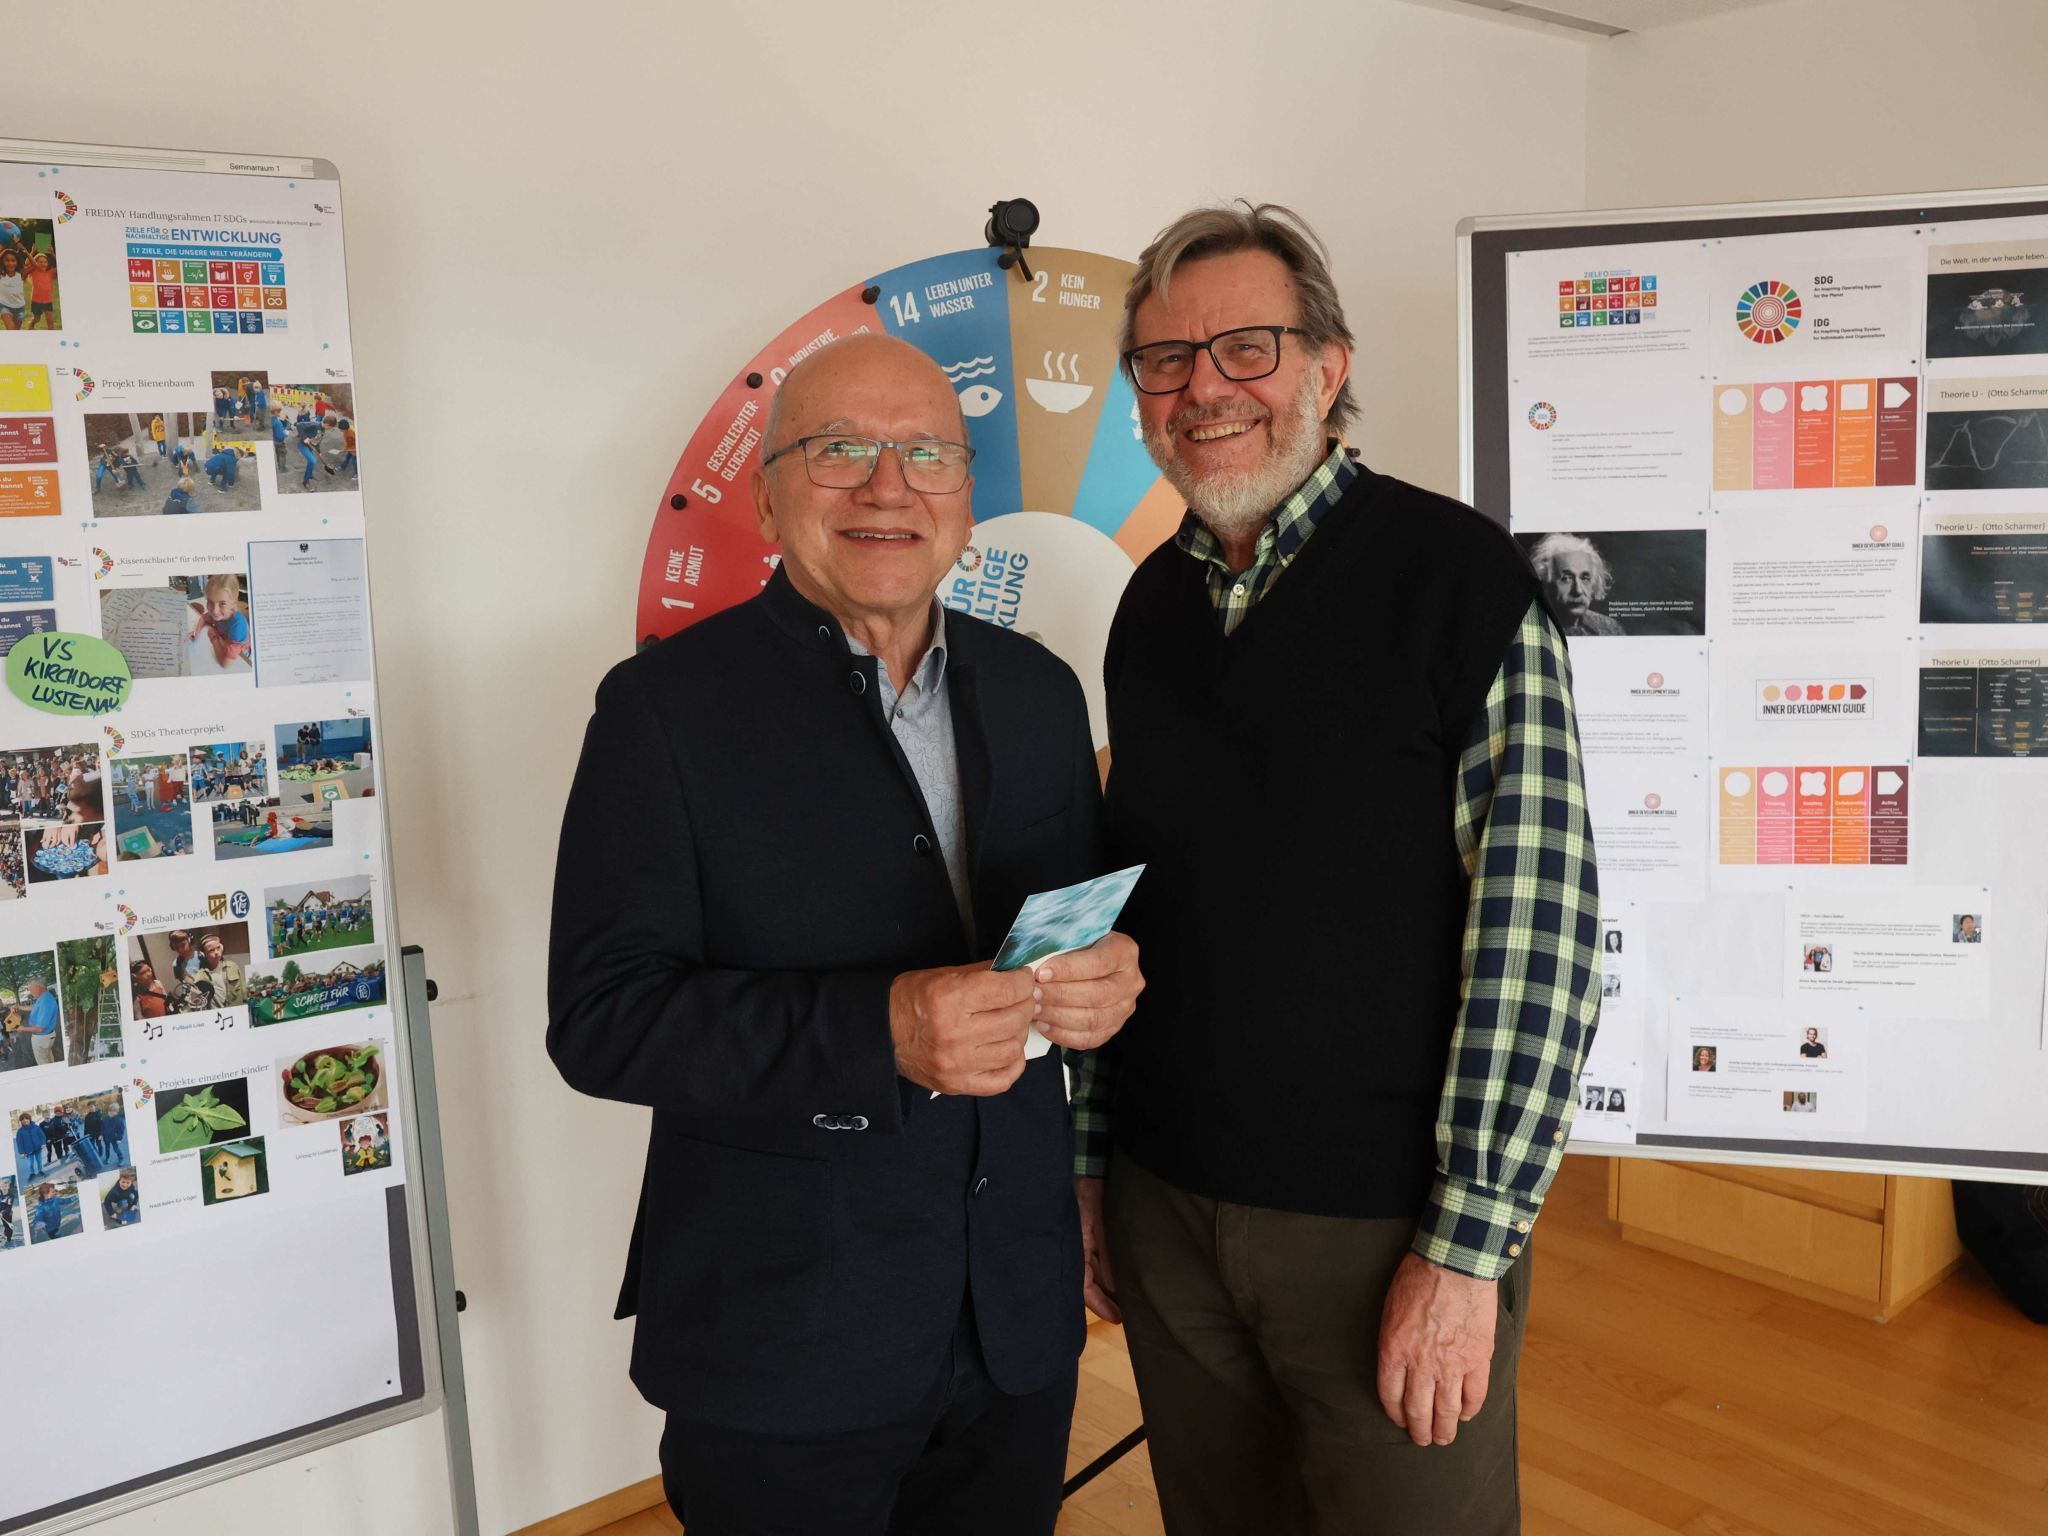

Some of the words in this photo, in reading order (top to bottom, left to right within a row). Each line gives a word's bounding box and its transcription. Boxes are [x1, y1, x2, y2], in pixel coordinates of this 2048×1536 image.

[230, 163, 274, 172] Seminarraum
[86, 208, 126, 218] FREIDAY
[129, 210, 211, 222] Handlungsrahmen
[213, 214, 222, 222] 17
[224, 215, 247, 224] SDGs
[125, 226, 145, 234] ZIELE
[171, 228, 281, 244] ENTWICKLUNG
[229, 250, 272, 258] VERÄNDERN
[1032, 270, 1048, 303] 2
[1061, 273, 1085, 290] KEIN
[1814, 276, 1833, 285] SDG
[890, 292, 921, 326] 14
[924, 280, 960, 301] LEBEN
[960, 272, 993, 292] UNTER
[929, 295, 974, 318] WASSER
[1059, 291, 1101, 310] HUNGER
[1814, 318, 1830, 327] IDG
[102, 379, 135, 389] Projekt
[138, 379, 194, 388] Bienenbaum
[1940, 391, 1969, 399] Theorie
[1987, 390, 2008, 398] (Otto
[706, 400, 758, 472] GESCHLECHTER-
[720, 426, 762, 482] GLEICHHEIT
[691, 478, 722, 504] 5
[1935, 523, 1964, 531] Theorie
[1982, 523, 2003, 531] (Otto
[2005, 522, 2046, 531] Scharmer)
[665, 548, 685, 583] KEINE
[684, 545, 704, 587] ARMUT
[975, 547, 1008, 616] LTIGE
[998, 553, 1028, 629] KLUNG
[661, 596, 695, 609] 1
[944, 578, 976, 614] ÜR
[43, 637, 73, 661] VS
[2001, 658, 2040, 666] Scharmer)
[24, 657, 128, 694] KIRCHDORF
[32, 685, 120, 713] LUSTENAU
[1763, 704, 1785, 715] INNER
[1787, 704, 1841, 714] DEVELOPMENT
[1843, 703, 1866, 713] GUIDE
[131, 728, 156, 739] SDGs
[158, 724, 225, 737] Theaterprojekt
[141, 912, 175, 925] Fußball
[177, 910, 208, 922] Projekt
[293, 990, 328, 1008] SCHREI
[330, 986, 349, 999] FÜR
[159, 1077, 196, 1090] Projekte
[198, 1071, 238, 1084] einzelner
[240, 1064, 270, 1076] Kinder
